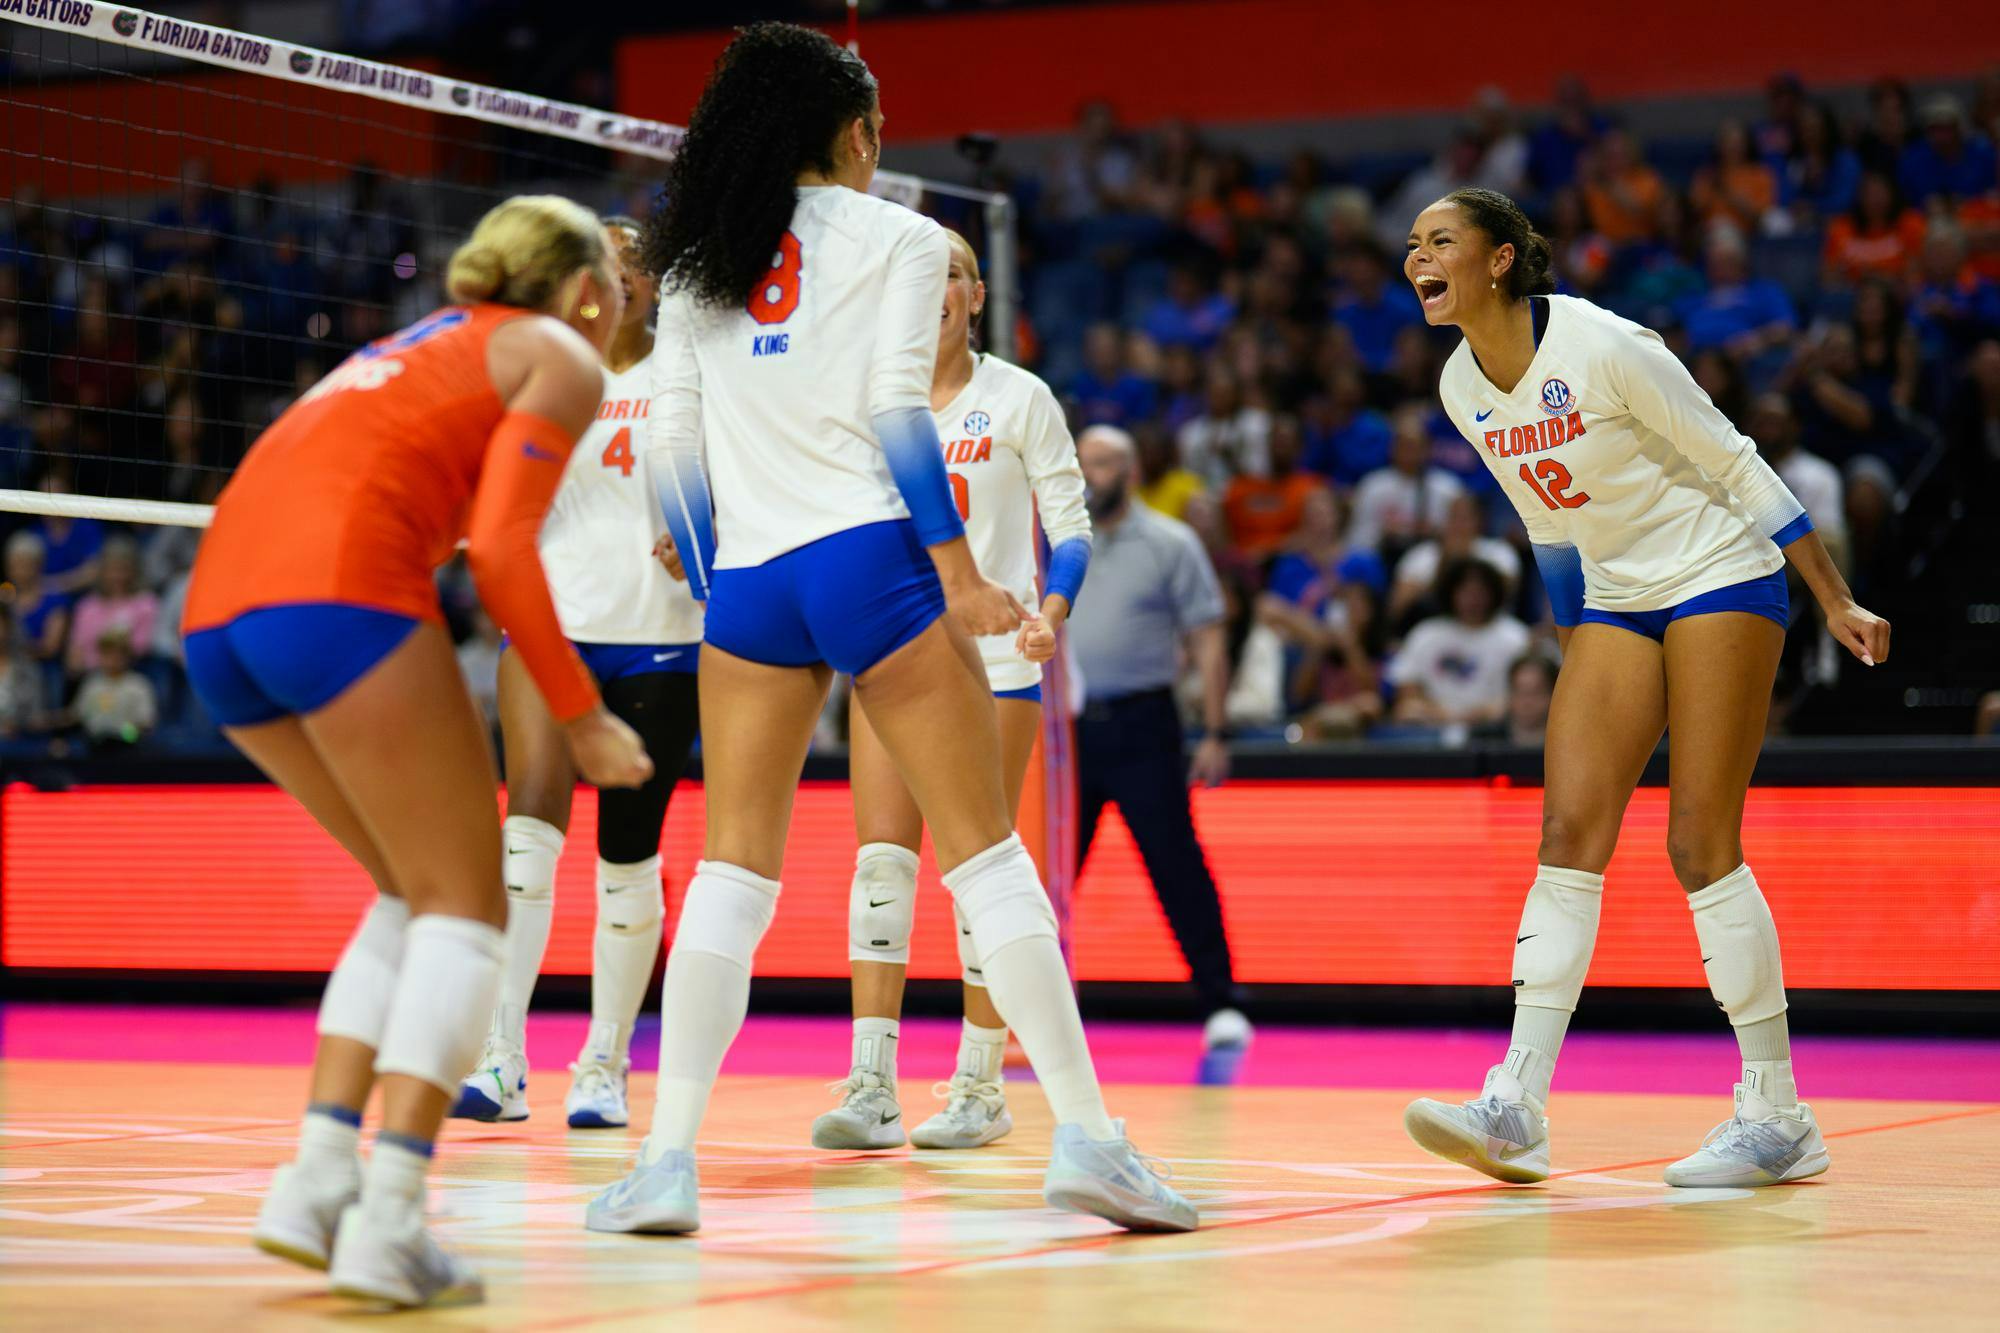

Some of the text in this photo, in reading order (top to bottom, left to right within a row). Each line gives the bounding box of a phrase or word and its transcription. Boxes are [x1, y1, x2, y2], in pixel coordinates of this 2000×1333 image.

[26, 0, 94, 26] GATORS
[141, 17, 273, 66] FLORIDA GATORS
[746, 229, 803, 325] 8
[752, 333, 790, 357] KING
[1543, 380, 1569, 407] SEC
[1543, 401, 1573, 416] GRADUATE
[602, 426, 637, 478] 4
[1484, 410, 1587, 458] FLORIDA
[1519, 457, 1592, 511] 12
